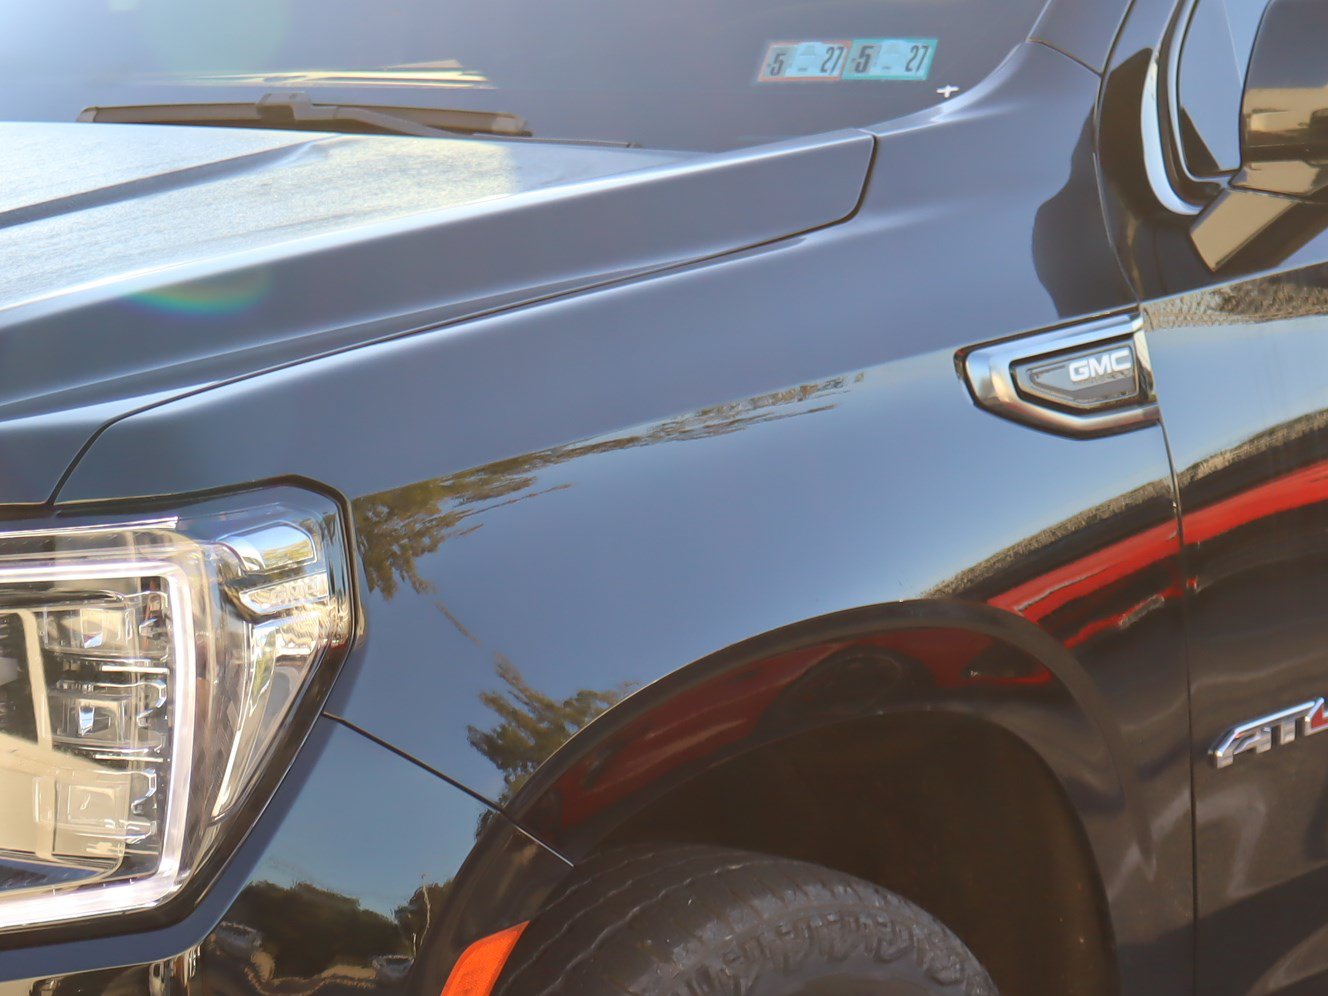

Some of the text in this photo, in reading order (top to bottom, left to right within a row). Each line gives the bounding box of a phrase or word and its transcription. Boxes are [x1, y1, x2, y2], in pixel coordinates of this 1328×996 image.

[770, 46, 845, 76] 5 27
[855, 45, 930, 74] 5 27
[1068, 349, 1132, 383] GMC
